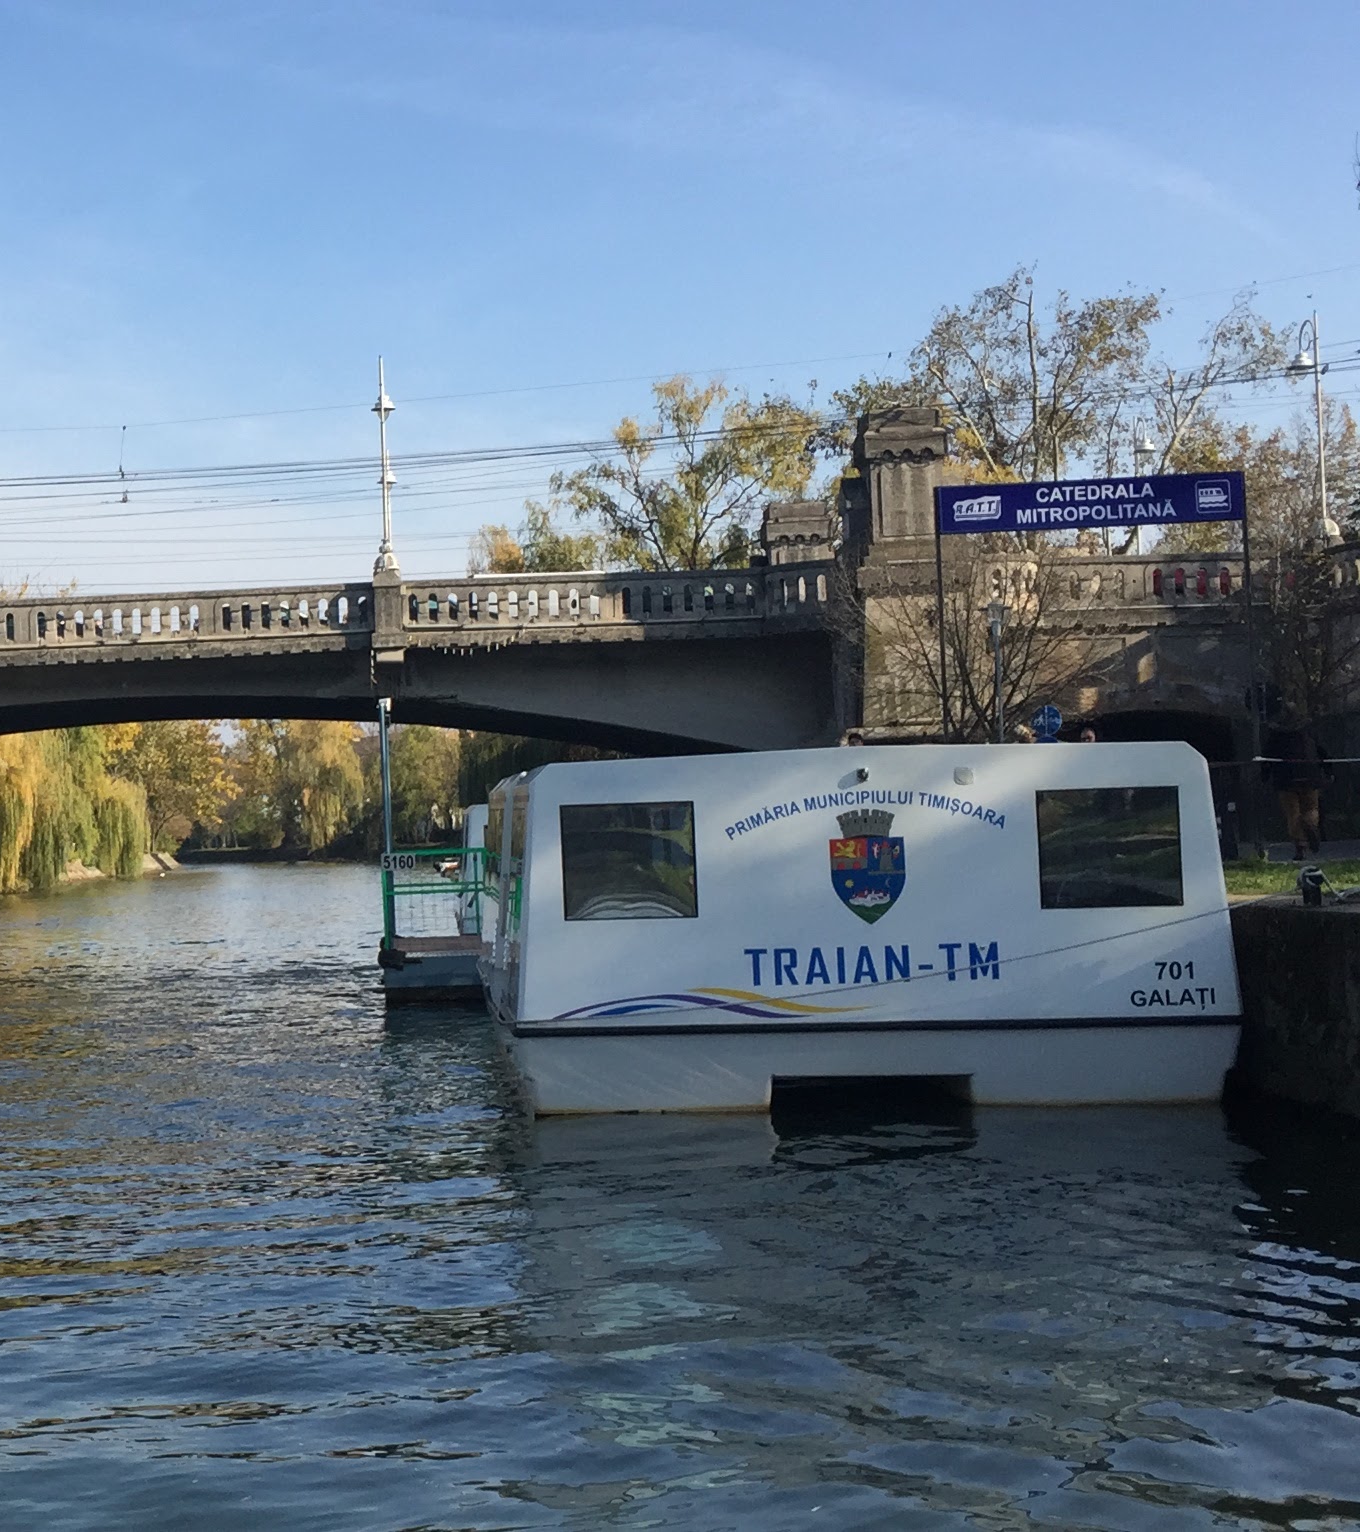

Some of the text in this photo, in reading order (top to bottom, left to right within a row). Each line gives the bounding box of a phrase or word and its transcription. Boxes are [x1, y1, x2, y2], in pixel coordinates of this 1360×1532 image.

[1035, 483, 1155, 503] CATEDRALA
[1016, 499, 1177, 525] MITROPOLITANĂ
[725, 790, 1006, 840] PRIMĂRIA MUNICIPIULUI TIMIȘOARA
[383, 855, 414, 869] 5160
[744, 941, 1000, 987] TRAIAN-TM
[1155, 961, 1194, 980] 701
[1130, 987, 1216, 1011] GALAȚI
